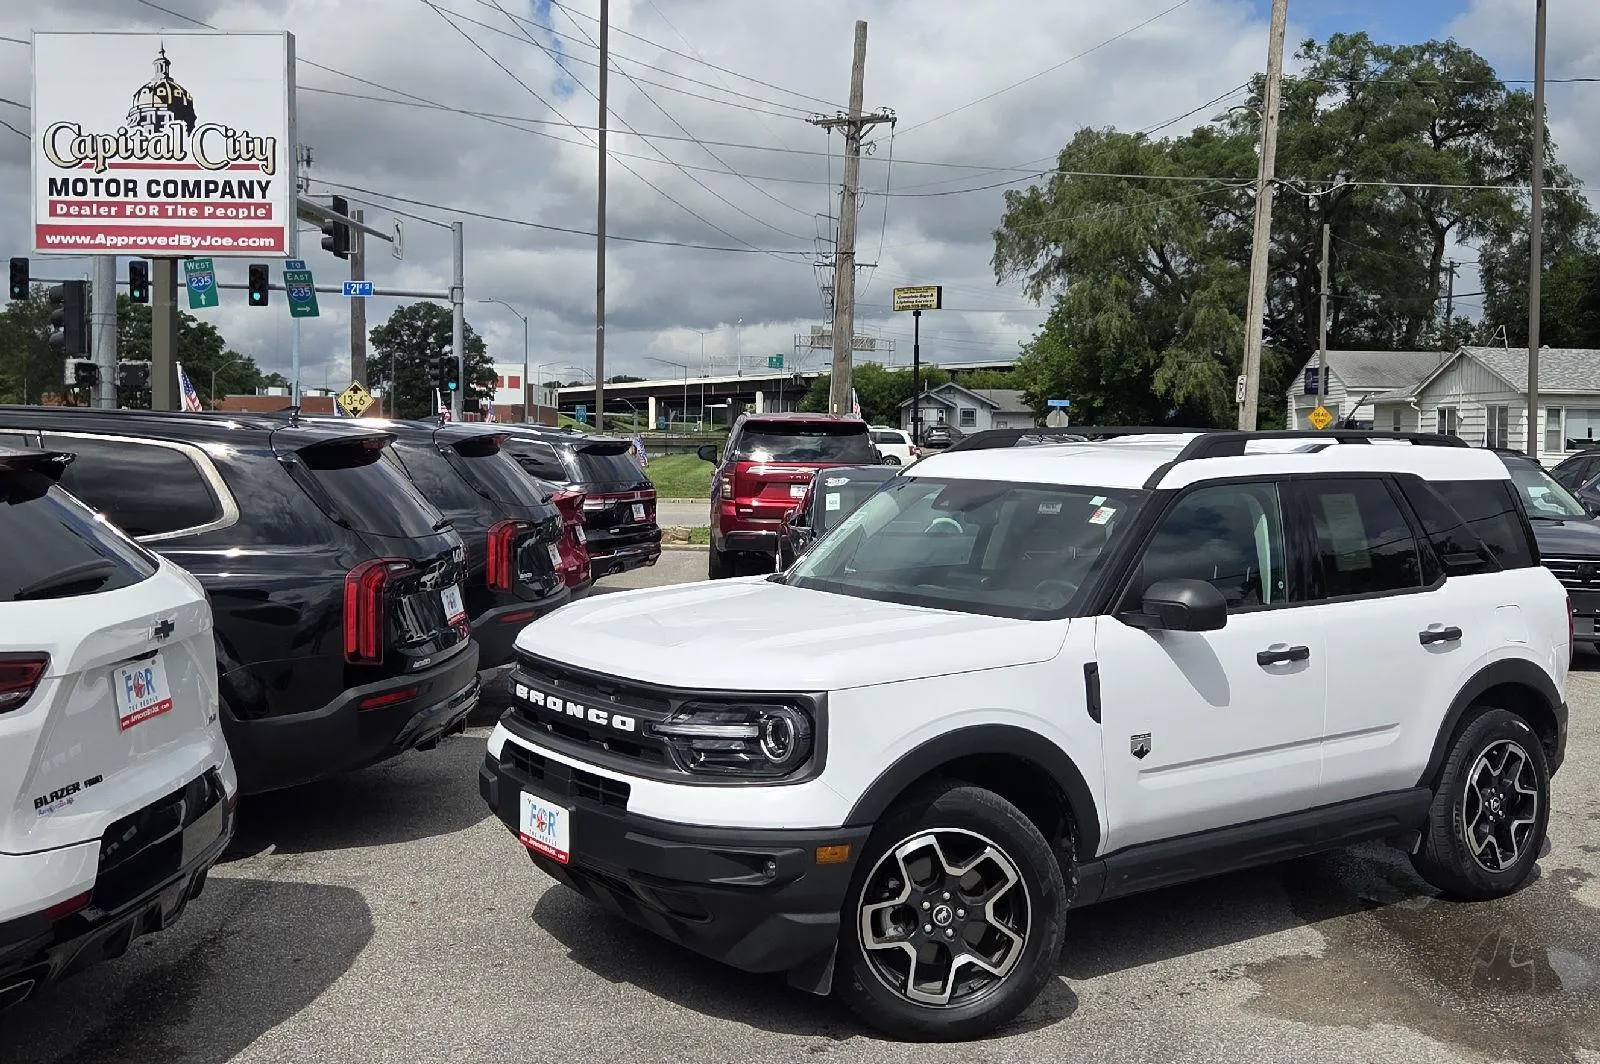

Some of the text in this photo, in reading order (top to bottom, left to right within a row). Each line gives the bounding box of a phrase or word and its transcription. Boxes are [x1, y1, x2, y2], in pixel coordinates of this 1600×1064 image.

[43, 121, 276, 175] Capital City
[48, 177, 272, 199] MOTOR COMPANY
[56, 203, 118, 216] Dealer
[125, 204, 159, 216] FOR
[165, 205, 199, 217] The
[45, 233, 275, 248] www.ApprovedByJoe.com
[186, 261, 210, 270] WEST
[191, 275, 212, 287] 235
[286, 273, 309, 281] EAST
[291, 286, 311, 297] 235
[124, 667, 156, 703] FOR
[516, 683, 635, 732] BRONCO
[34, 781, 81, 810] BLAZER
[529, 803, 557, 838] FOR
